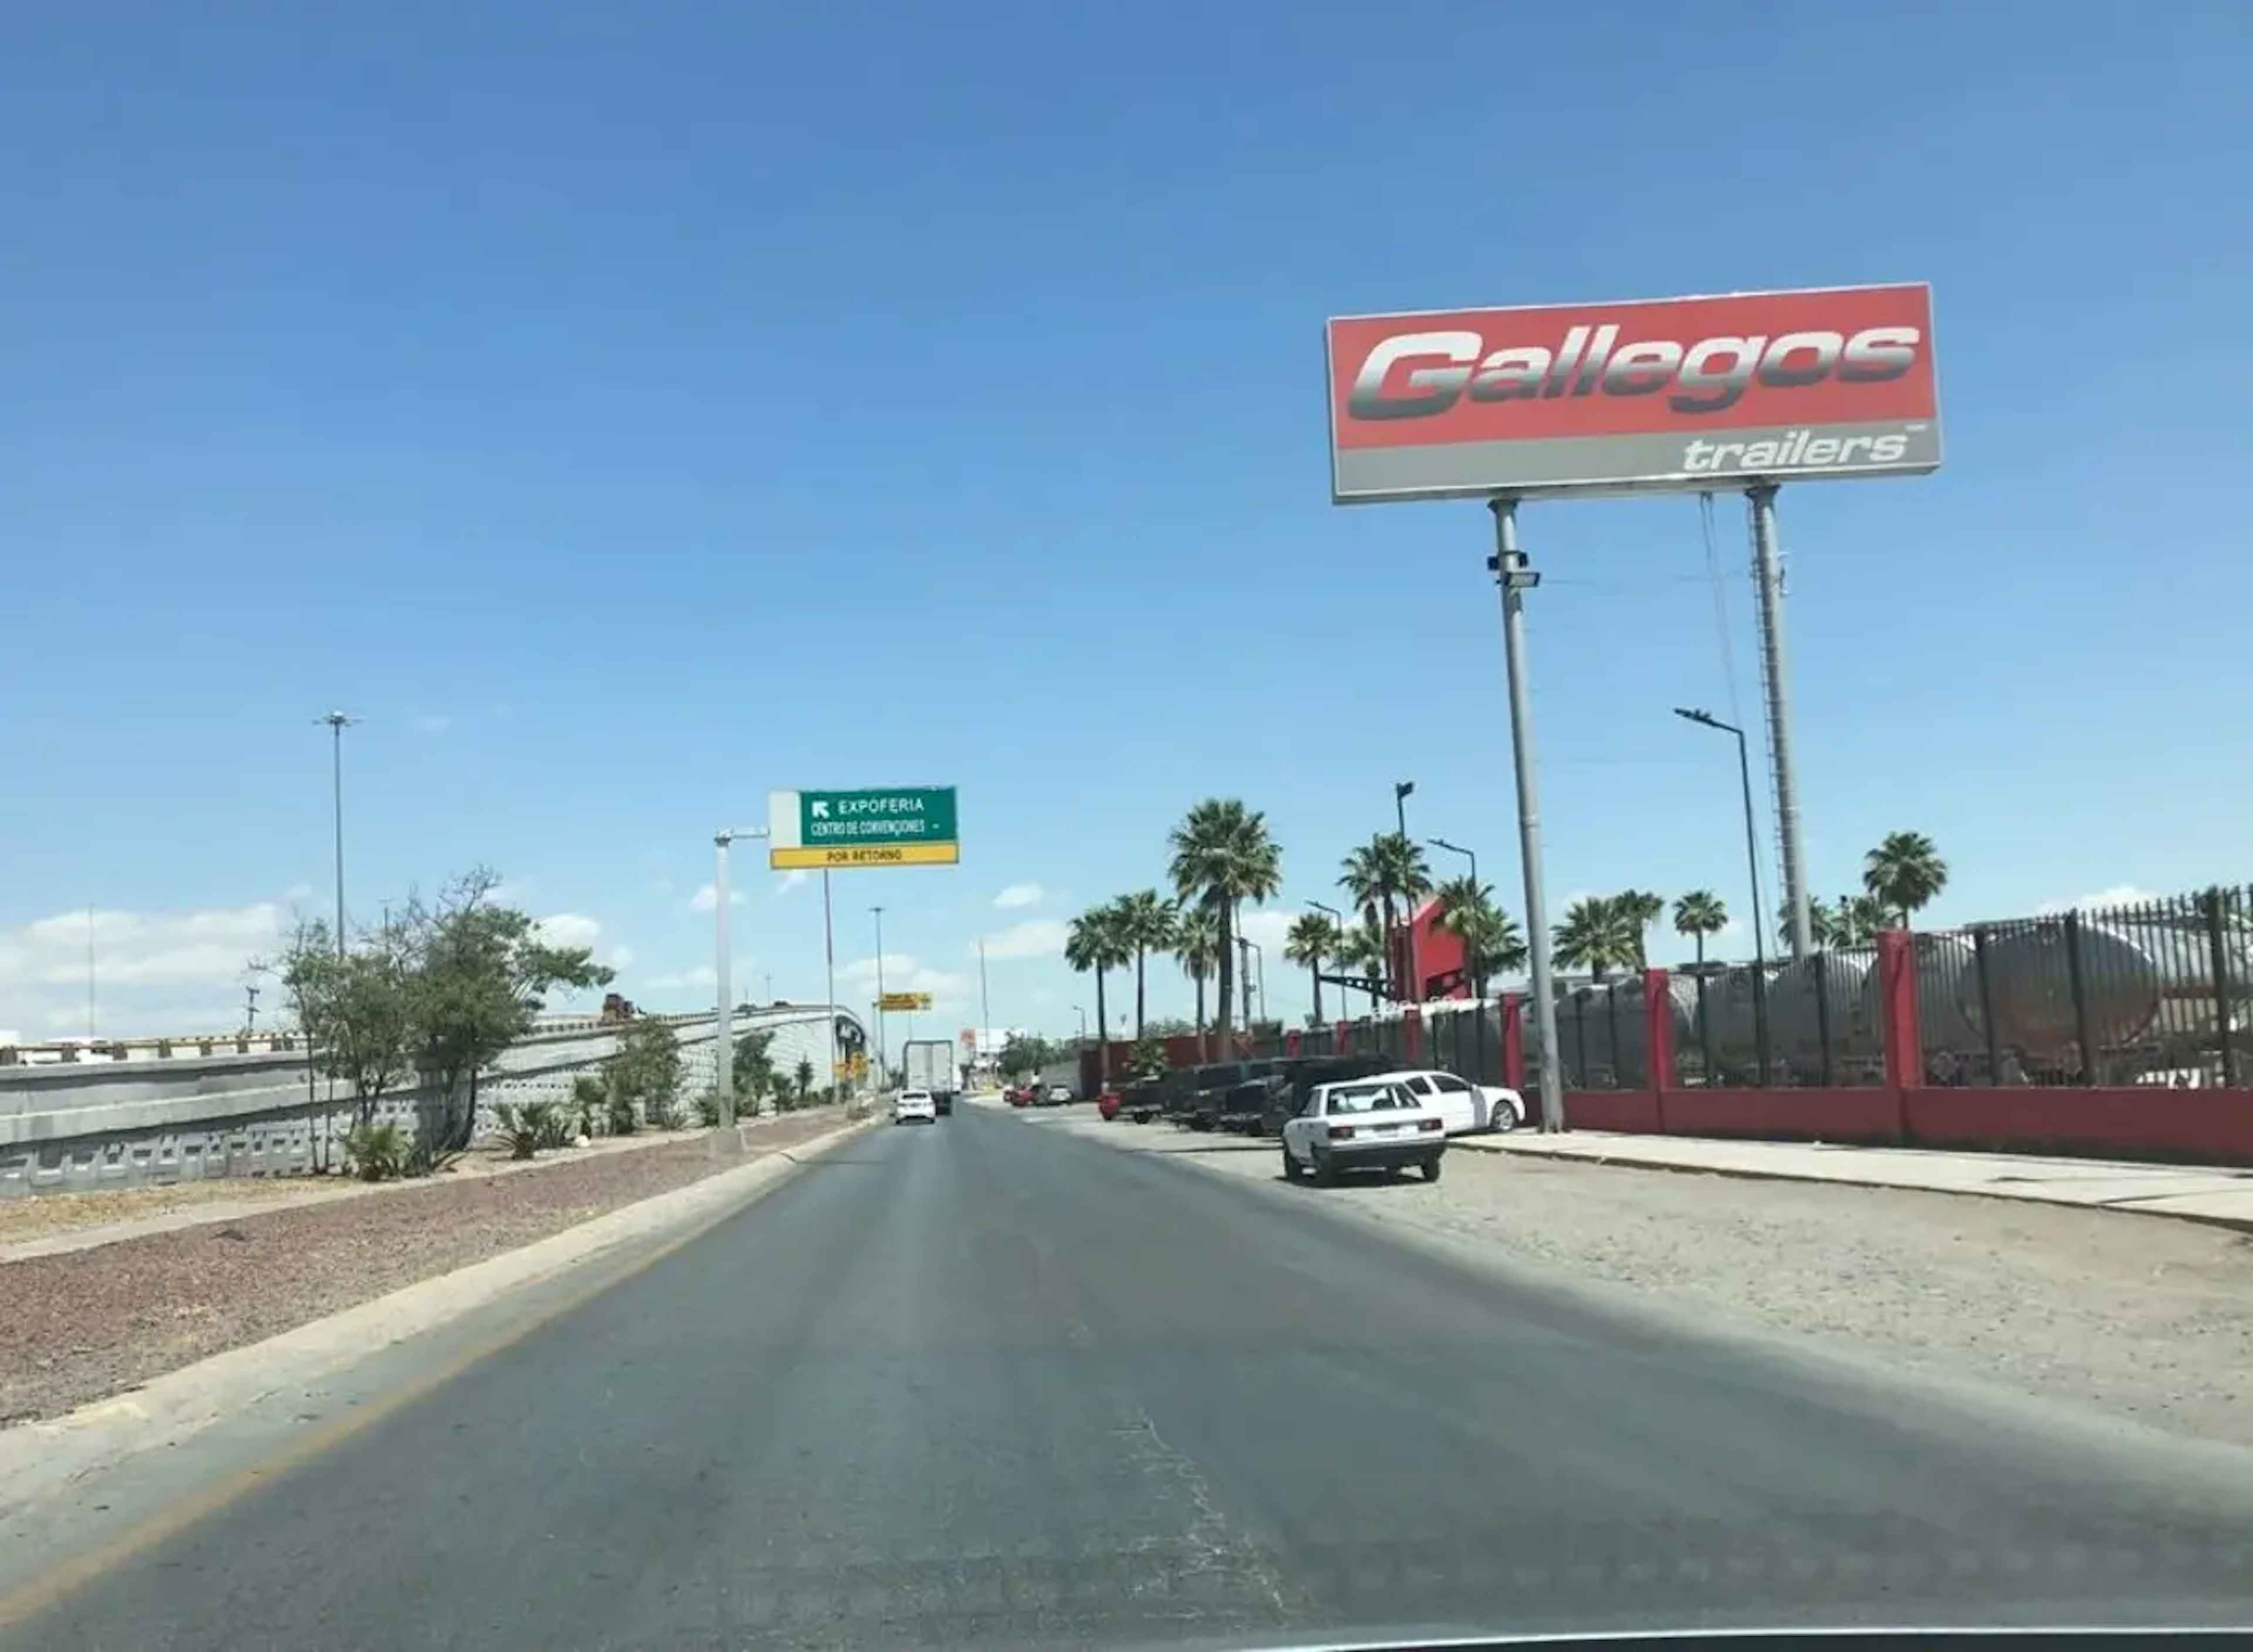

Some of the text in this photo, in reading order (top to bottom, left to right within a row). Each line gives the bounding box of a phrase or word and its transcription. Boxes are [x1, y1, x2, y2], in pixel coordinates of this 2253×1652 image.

[1347, 323, 1920, 421] Gallegos
[1683, 429, 1908, 470] trailers
[838, 797, 925, 814] EXPOFERIA
[810, 819, 925, 837] CENTRO DE CONVENCIONES
[827, 848, 902, 862] POR RETORNO
